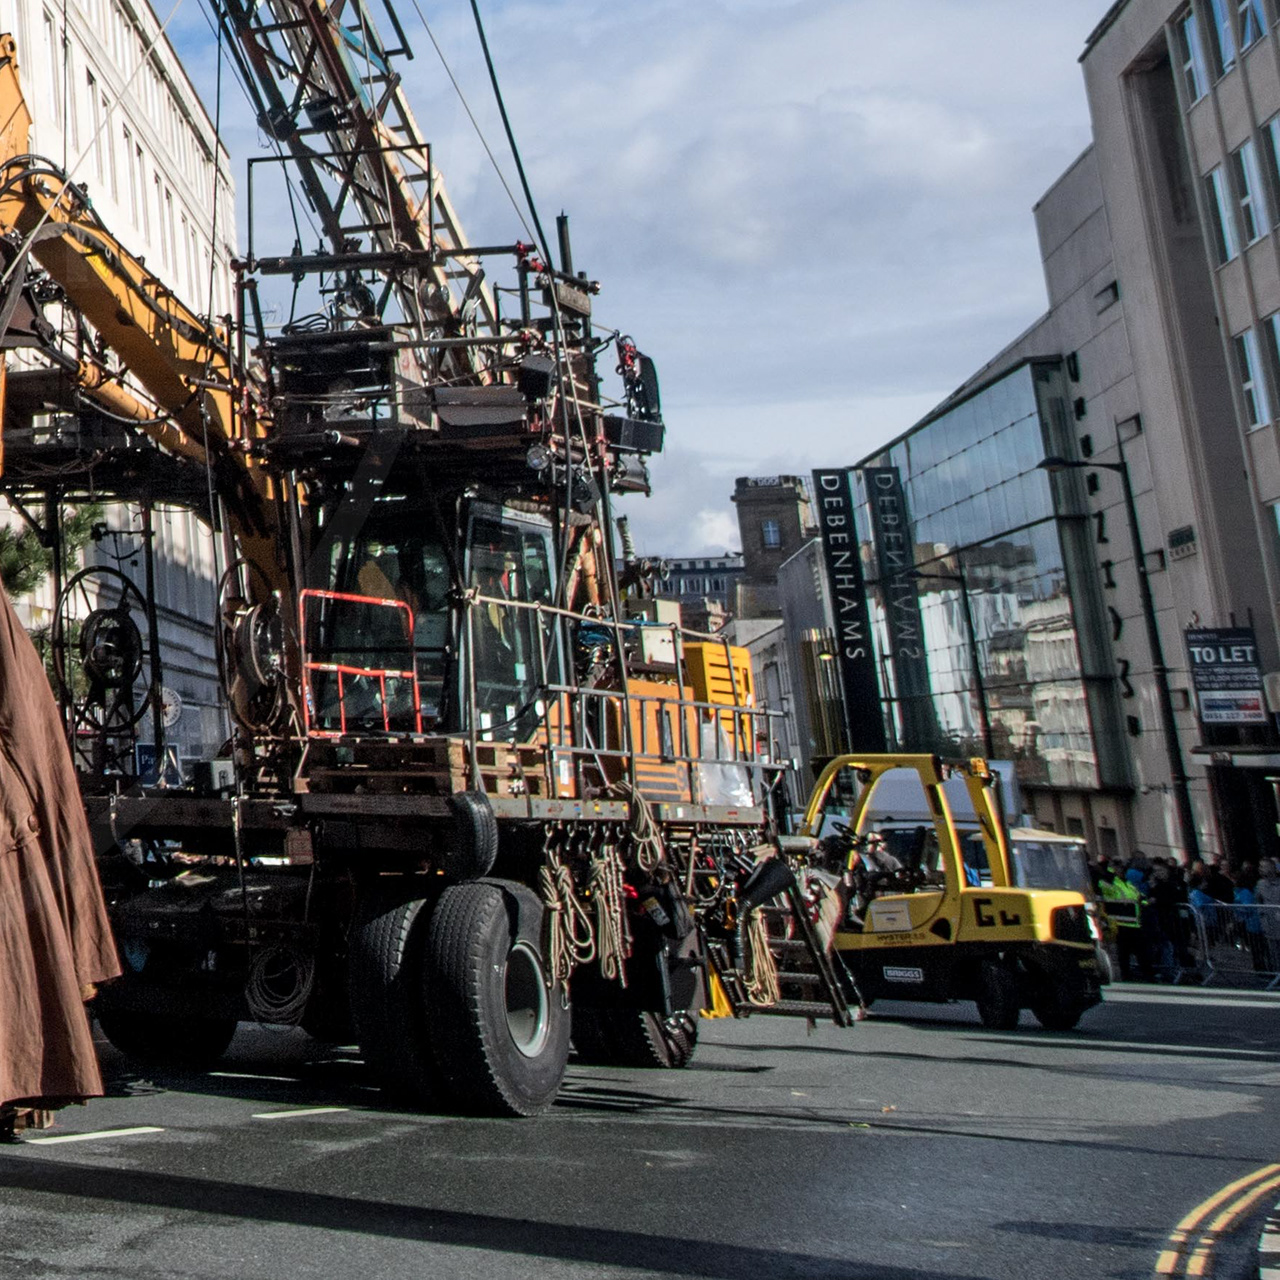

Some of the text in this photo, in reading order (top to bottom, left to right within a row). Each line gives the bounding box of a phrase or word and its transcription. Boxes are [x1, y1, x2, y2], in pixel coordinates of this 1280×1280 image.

[820, 475, 866, 659] DEBENHAMS
[1189, 646, 1255, 663] TO LET
